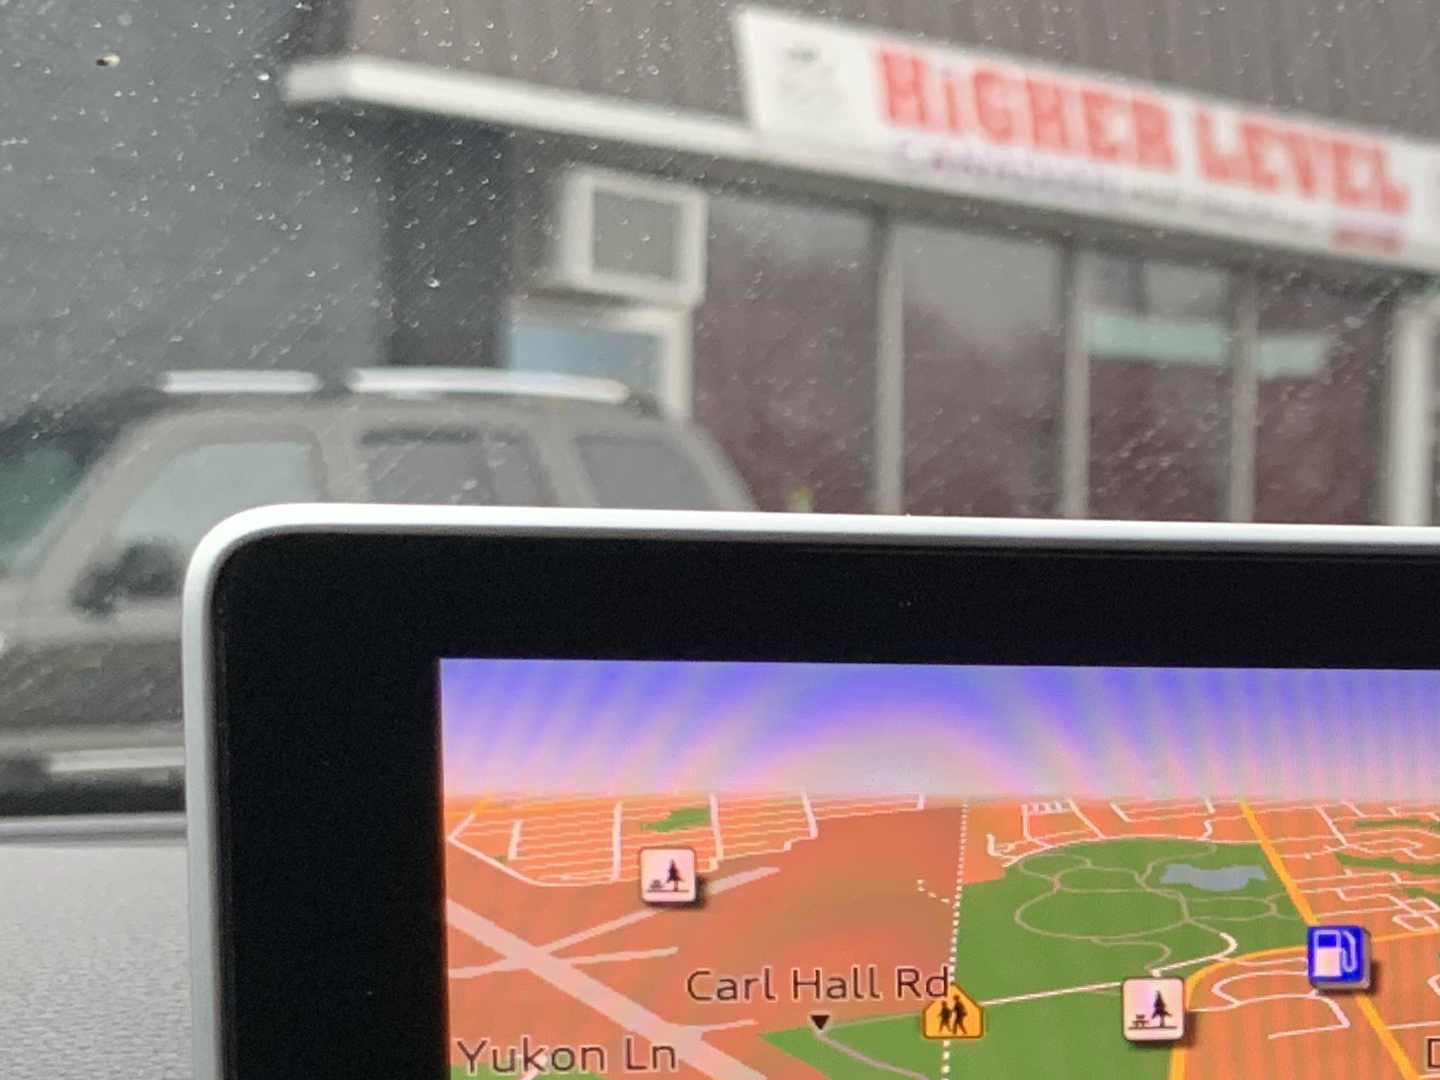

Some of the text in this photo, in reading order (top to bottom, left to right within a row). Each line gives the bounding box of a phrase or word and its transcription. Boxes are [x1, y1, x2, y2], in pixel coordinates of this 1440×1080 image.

[1194, 101, 1411, 215] LEVEL
[687, 965, 951, 1001] Carl Hall Rd
[457, 1037, 678, 1073] Yukon Ln
